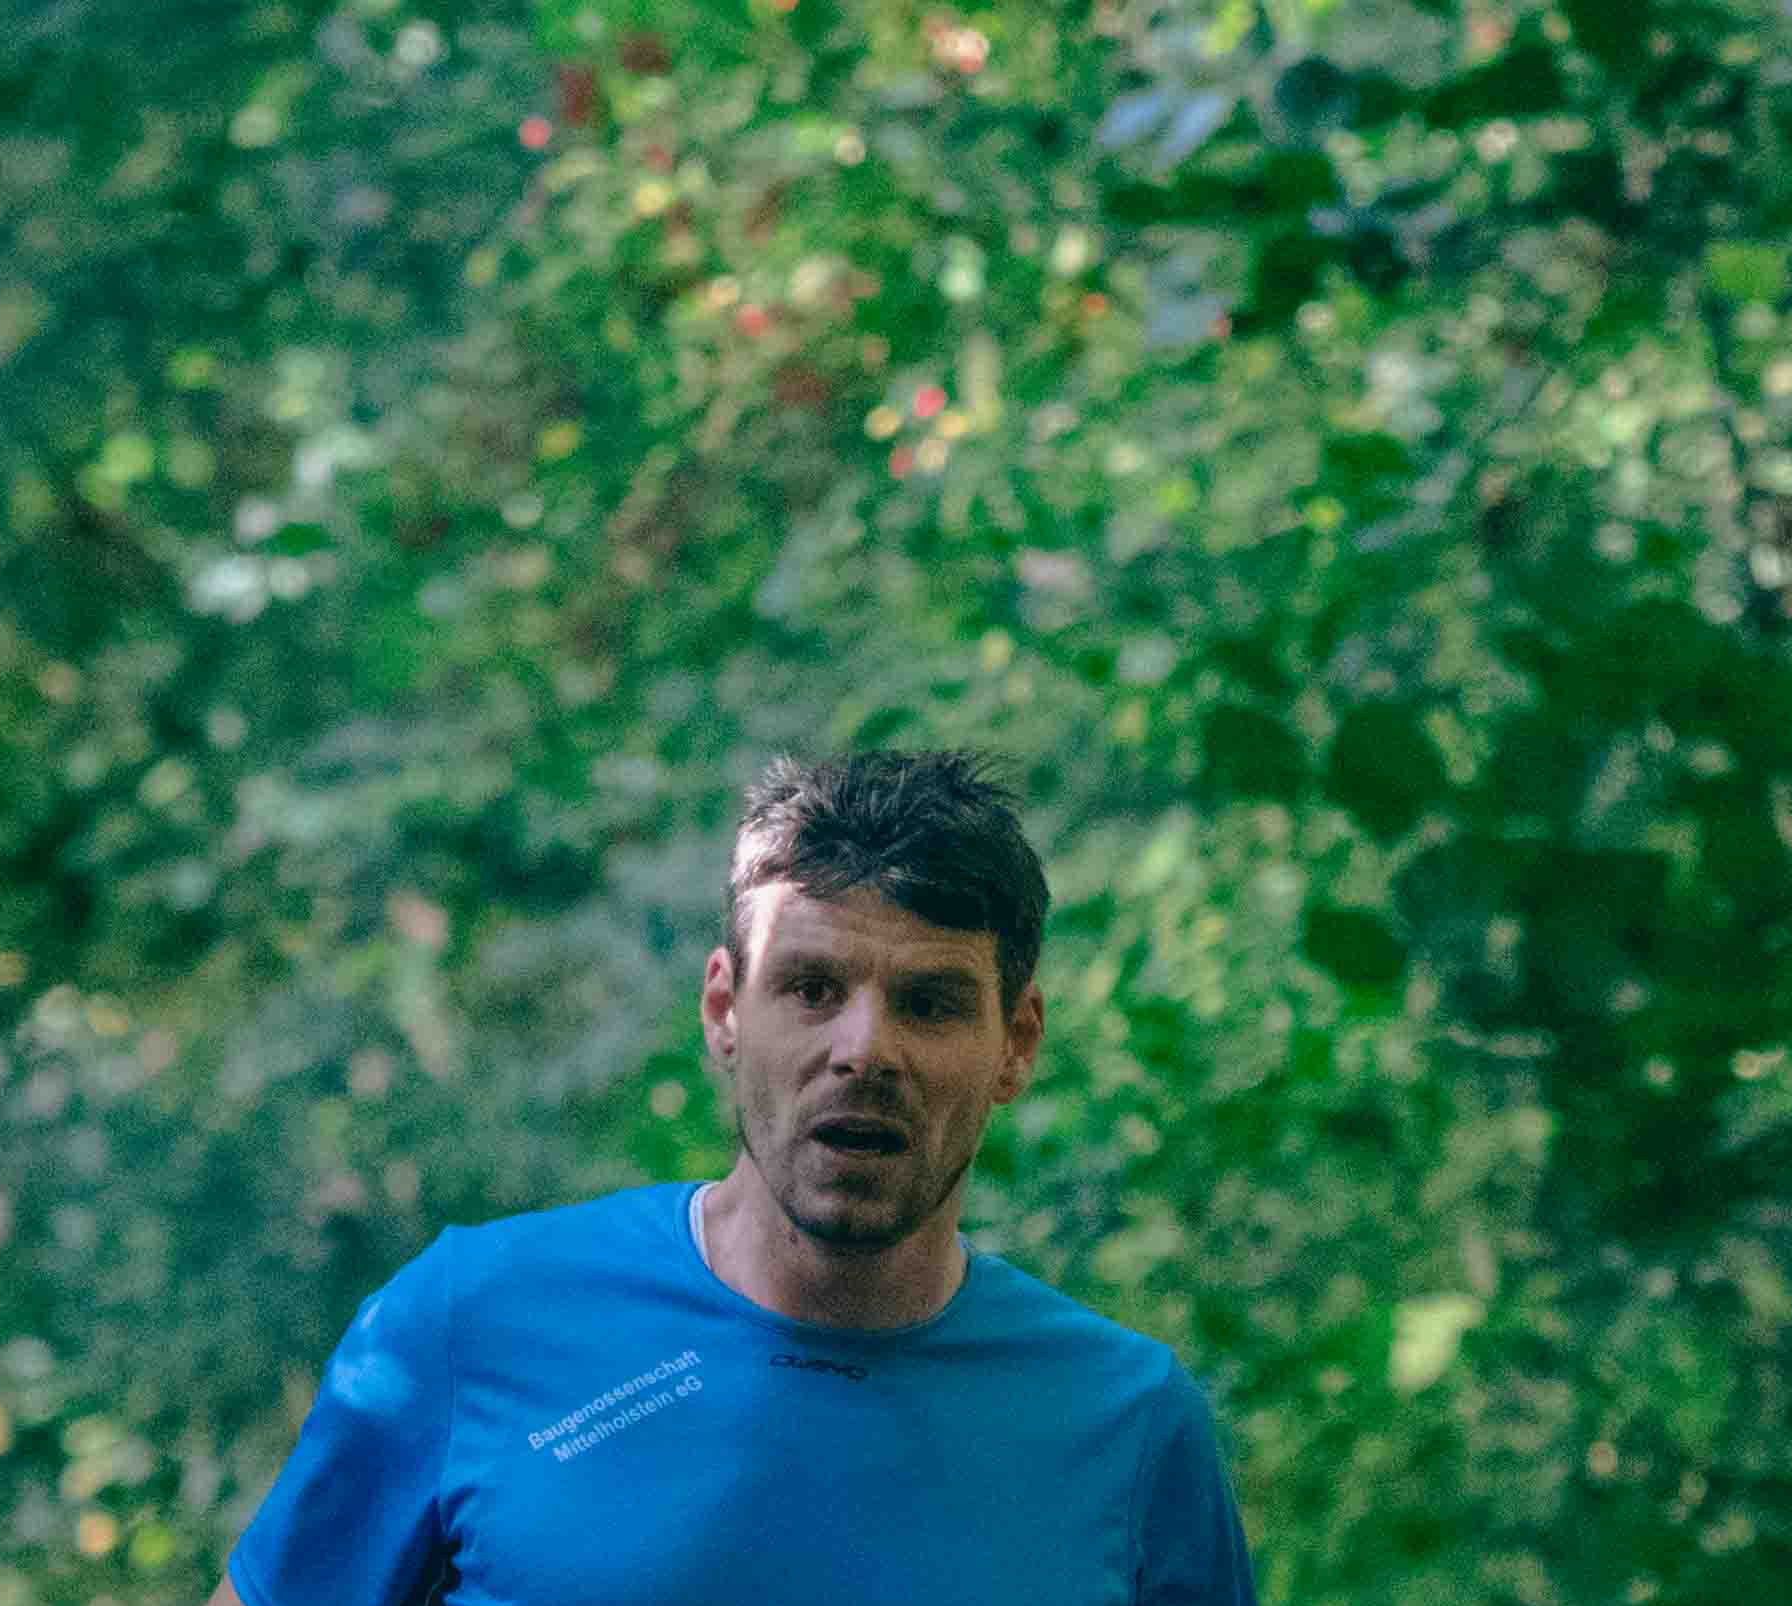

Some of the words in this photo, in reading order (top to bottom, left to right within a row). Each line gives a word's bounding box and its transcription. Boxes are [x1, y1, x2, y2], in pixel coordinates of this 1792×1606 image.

[528, 1350, 702, 1449] Baugenossenschaft
[553, 1390, 675, 1463] Mittelholstein
[675, 1376, 703, 1397] eG
